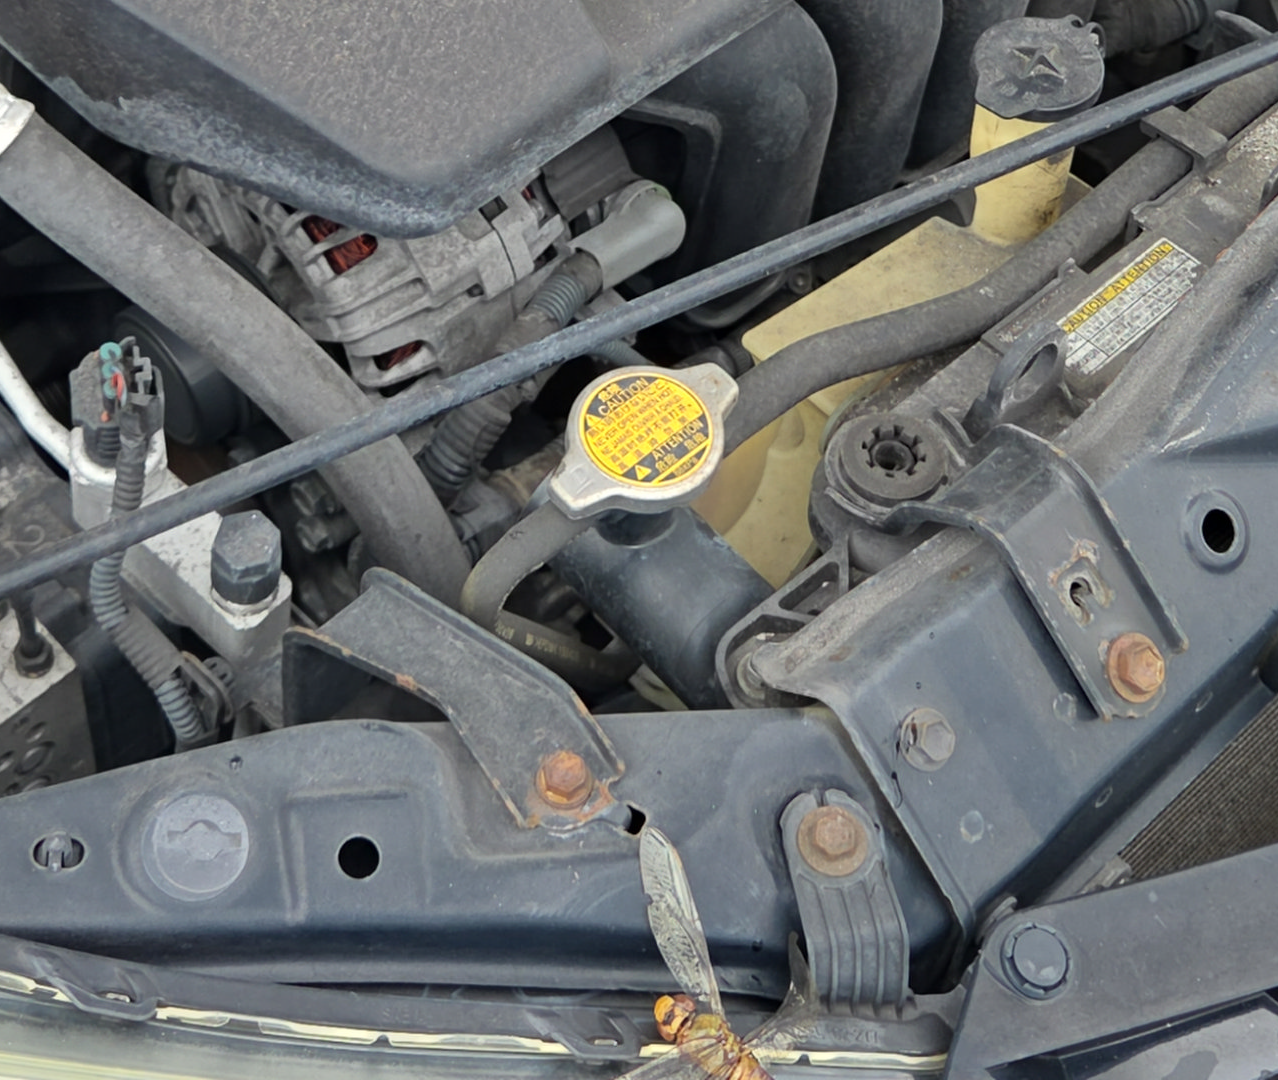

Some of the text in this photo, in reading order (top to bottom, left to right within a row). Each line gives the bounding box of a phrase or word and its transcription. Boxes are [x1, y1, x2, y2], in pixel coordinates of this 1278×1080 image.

[448, 168, 599, 228] DUAL
[1066, 296, 1108, 333] AUTION
[598, 377, 650, 416] CAUTION
[651, 418, 704, 461] ATTENTION
